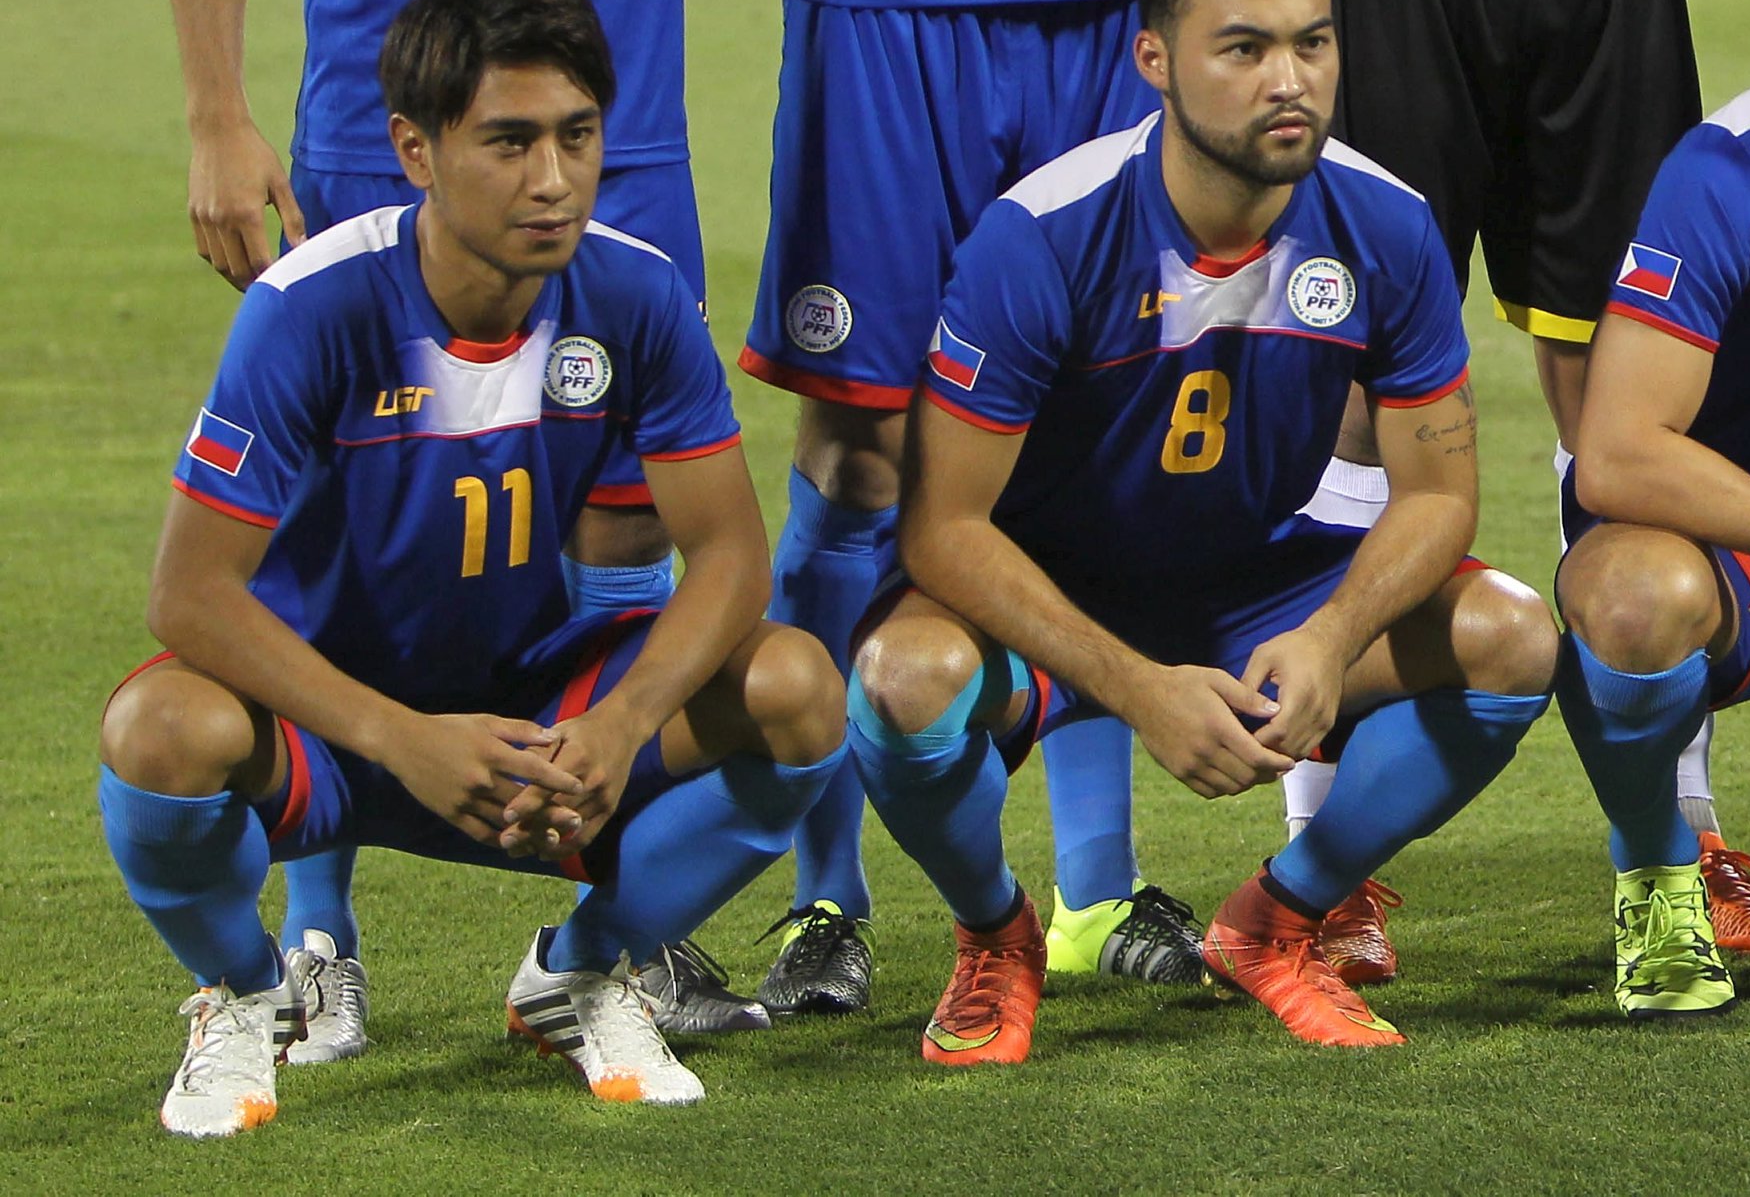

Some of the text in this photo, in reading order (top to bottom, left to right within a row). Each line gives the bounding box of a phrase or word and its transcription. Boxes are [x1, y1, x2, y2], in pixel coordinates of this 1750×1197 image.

[1306, 296, 1340, 311] PFF
[802, 321, 836, 337] PFF
[560, 375, 596, 389] PFF
[1161, 370, 1230, 473] 8
[455, 468, 532, 577] 11
